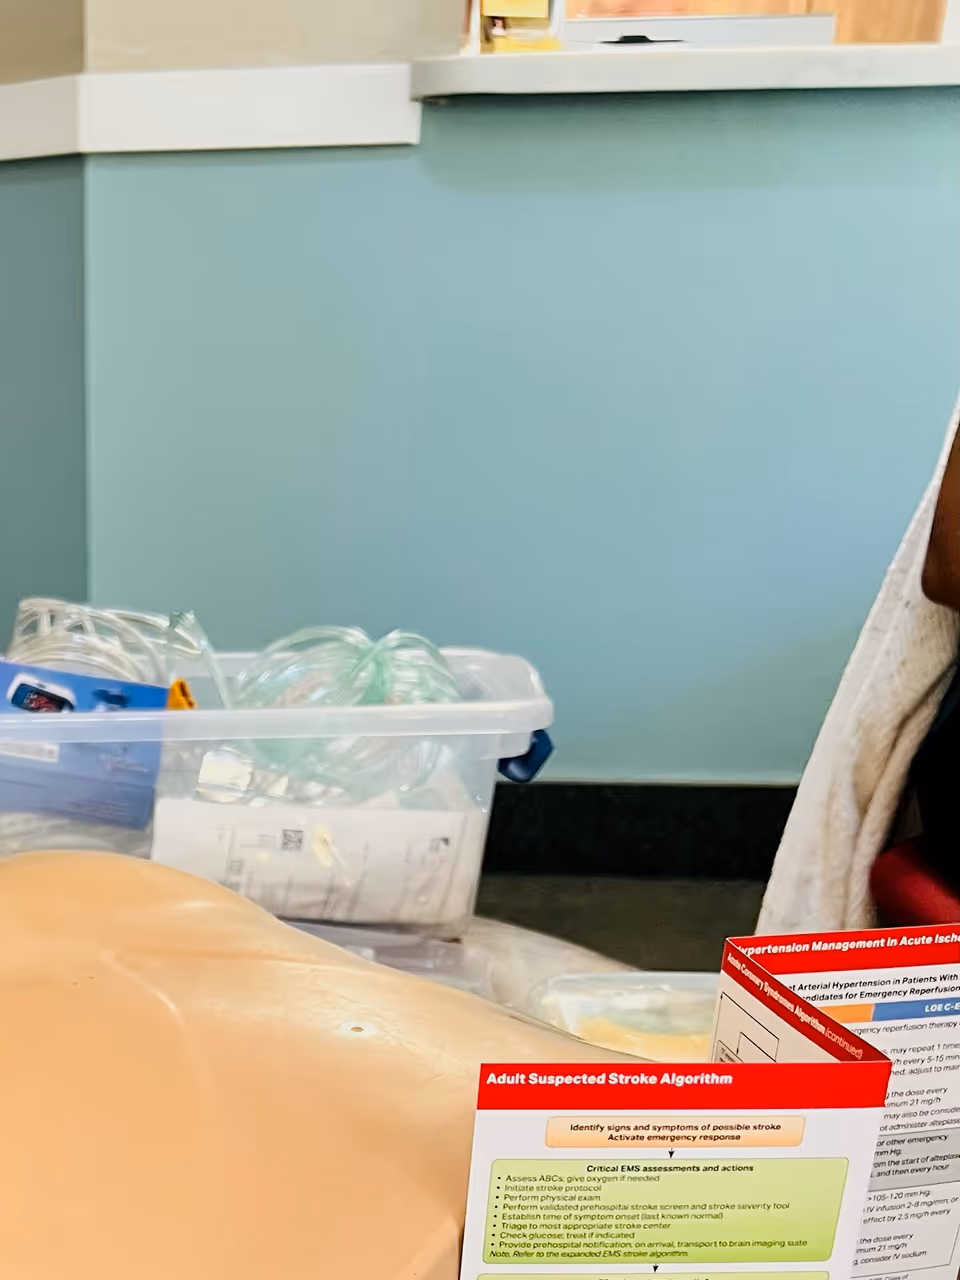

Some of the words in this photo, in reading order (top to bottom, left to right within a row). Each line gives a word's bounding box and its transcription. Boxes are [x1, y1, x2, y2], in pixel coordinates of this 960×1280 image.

[811, 938, 885, 951] Management
[886, 936, 897, 946] in
[898, 935, 932, 945] Acute
[797, 982, 830, 990] Arterial
[832, 979, 890, 990] Hypertension
[939, 973, 958, 982] With
[859, 990, 907, 998] Emergency
[909, 984, 960, 995] Reperfusion
[794, 1005, 826, 1035] Algorithm
[825, 1027, 863, 1060] (continued)
[908, 1044, 934, 1052] repeat
[486, 1072, 525, 1084] Adult
[528, 1072, 606, 1086] Suspected
[608, 1072, 657, 1084] Stroke
[659, 1072, 732, 1086] Algorithm
[570, 1123, 604, 1132] Identify
